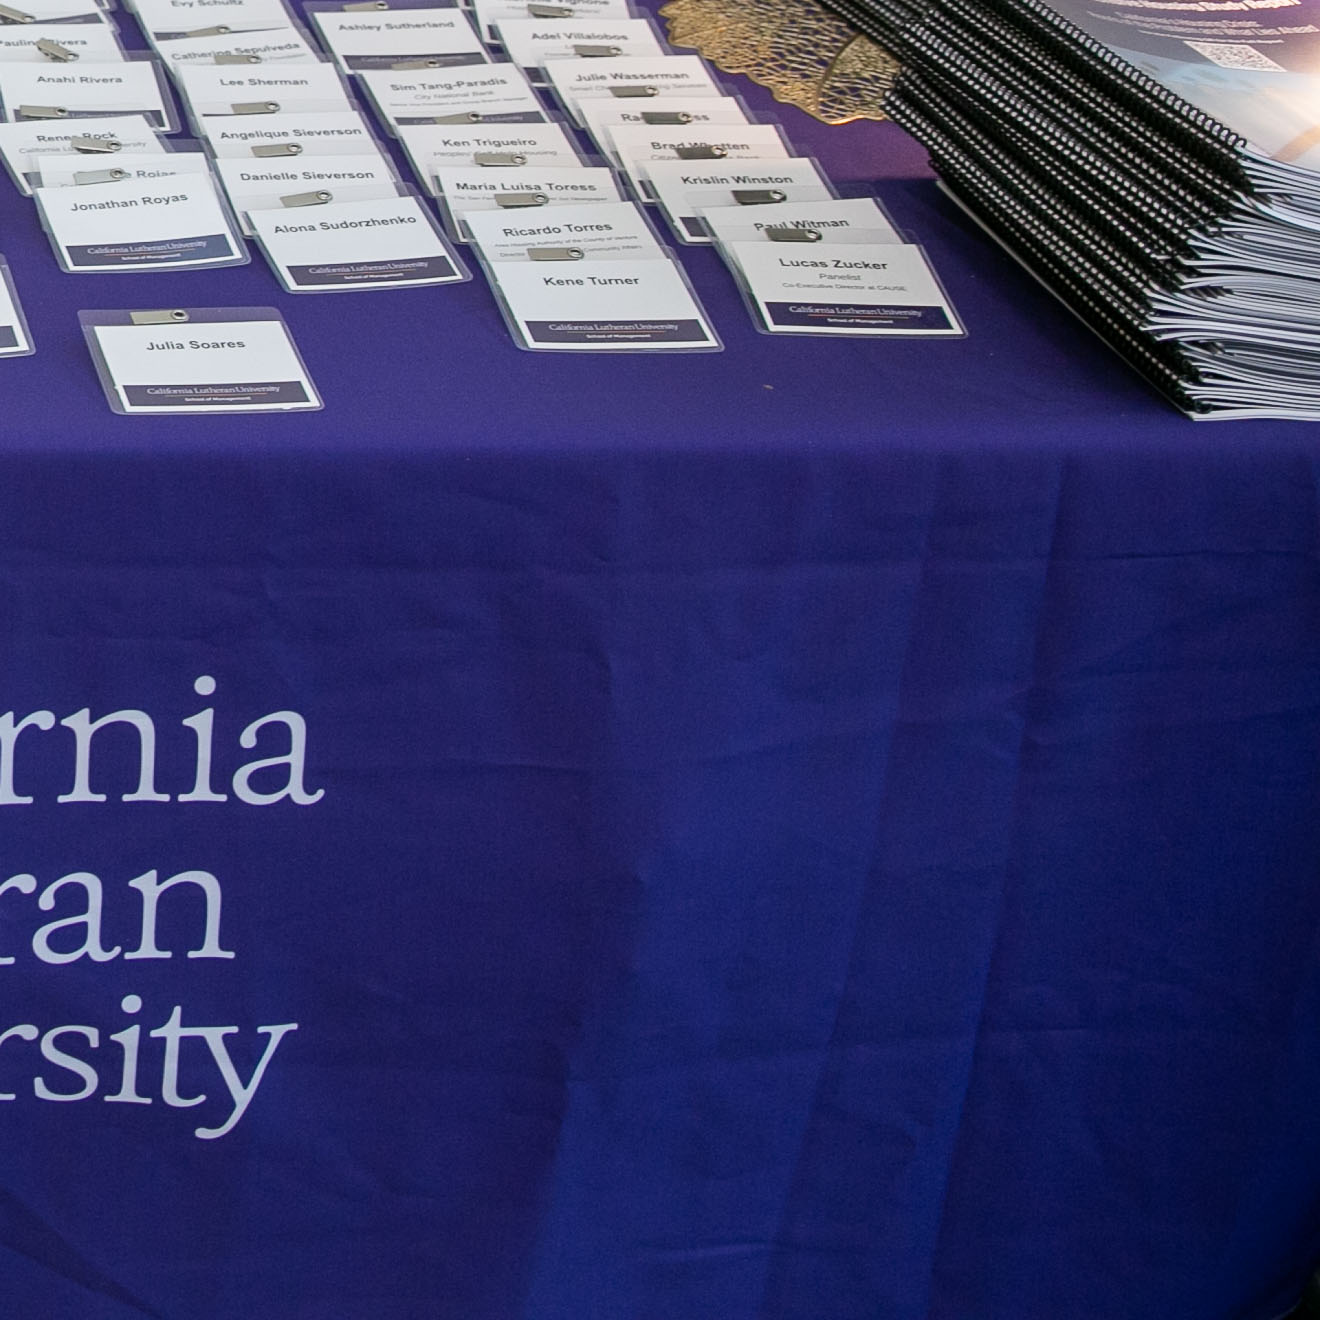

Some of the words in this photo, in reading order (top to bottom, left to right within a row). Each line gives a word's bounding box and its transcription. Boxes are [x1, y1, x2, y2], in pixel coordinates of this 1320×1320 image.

[339, 22, 381, 31] Ashley
[386, 21, 455, 29] Sutherland
[576, 73, 606, 81] Julie
[610, 72, 689, 80] Wasserman
[420, 78, 507, 91] Tang-Paradis
[220, 130, 288, 140] Angelique
[293, 128, 362, 137] Sieverson
[442, 139, 469, 147] Ken
[473, 139, 537, 149] Trigueiro
[240, 172, 297, 181] Danielle
[303, 171, 374, 180] Sieverson
[681, 176, 729, 184] Krislin
[733, 175, 793, 184] Winston
[456, 182, 496, 192] Maria
[502, 182, 541, 191] Luisa
[546, 183, 597, 192] Toress
[71, 198, 138, 211] Jonathan
[142, 193, 188, 205] Royas
[274, 223, 316, 234] Alona
[320, 215, 416, 231] Sudorzhenko
[791, 218, 849, 229] Witman
[503, 225, 561, 237] Ricardo
[565, 222, 612, 232] Torres
[779, 258, 827, 268] Lucas
[832, 260, 888, 270] Zucker
[544, 277, 583, 286] Kene
[588, 277, 639, 285] Turner
[147, 341, 184, 351] Julia
[190, 340, 245, 349] Soares
[147, 387, 192, 395] California
